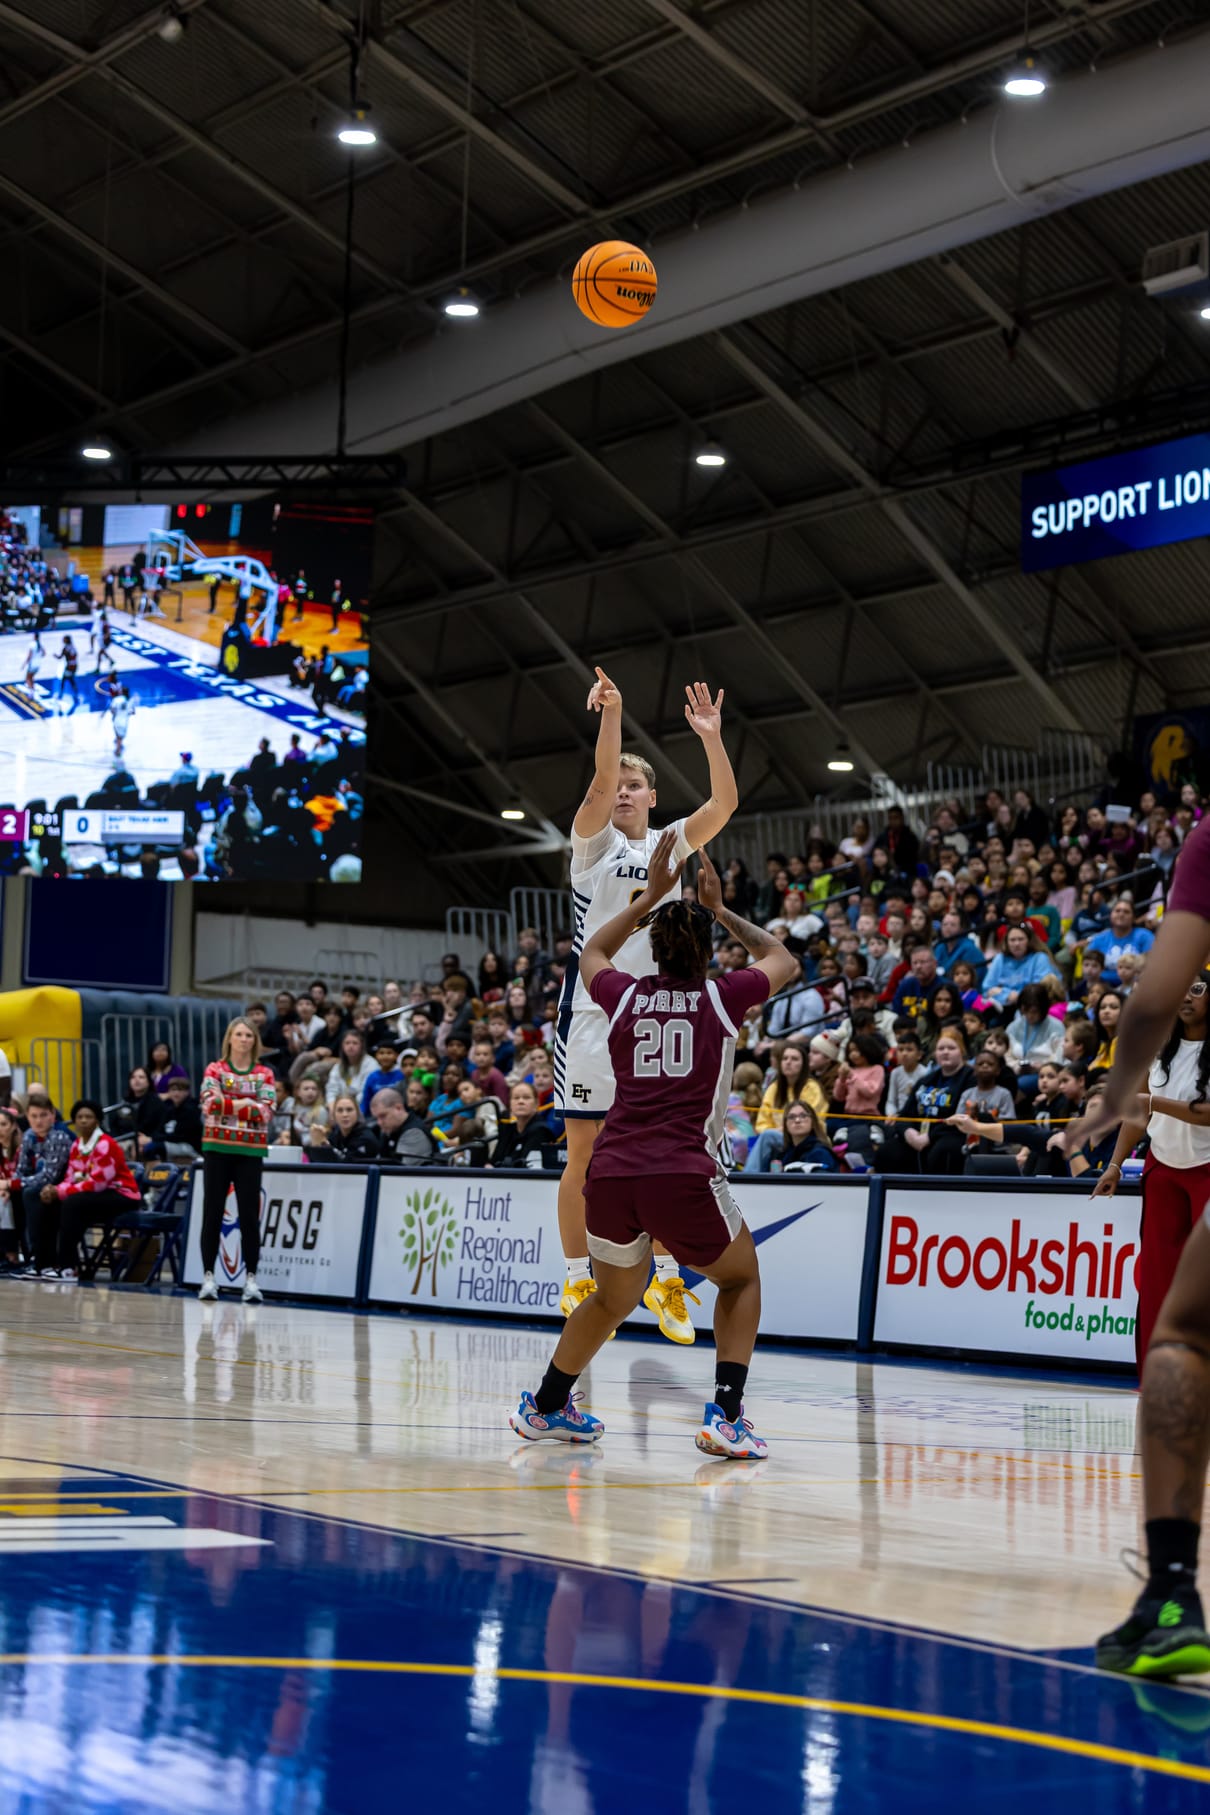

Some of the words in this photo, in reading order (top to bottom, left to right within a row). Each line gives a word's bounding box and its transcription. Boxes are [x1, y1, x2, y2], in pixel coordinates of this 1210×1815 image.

[1031, 481, 1152, 538] SUPPORT
[168, 659, 287, 708] TEXAS
[77, 816, 89, 833] 0
[616, 865, 649, 881] LIO
[633, 1018, 693, 1077] 20
[572, 1083, 592, 1103] ET
[261, 1199, 323, 1250] ASG
[464, 1187, 512, 1222] Hunt
[460, 1226, 542, 1274] Regional
[886, 1215, 1141, 1299] Brookshir
[457, 1265, 560, 1308] Healthcare
